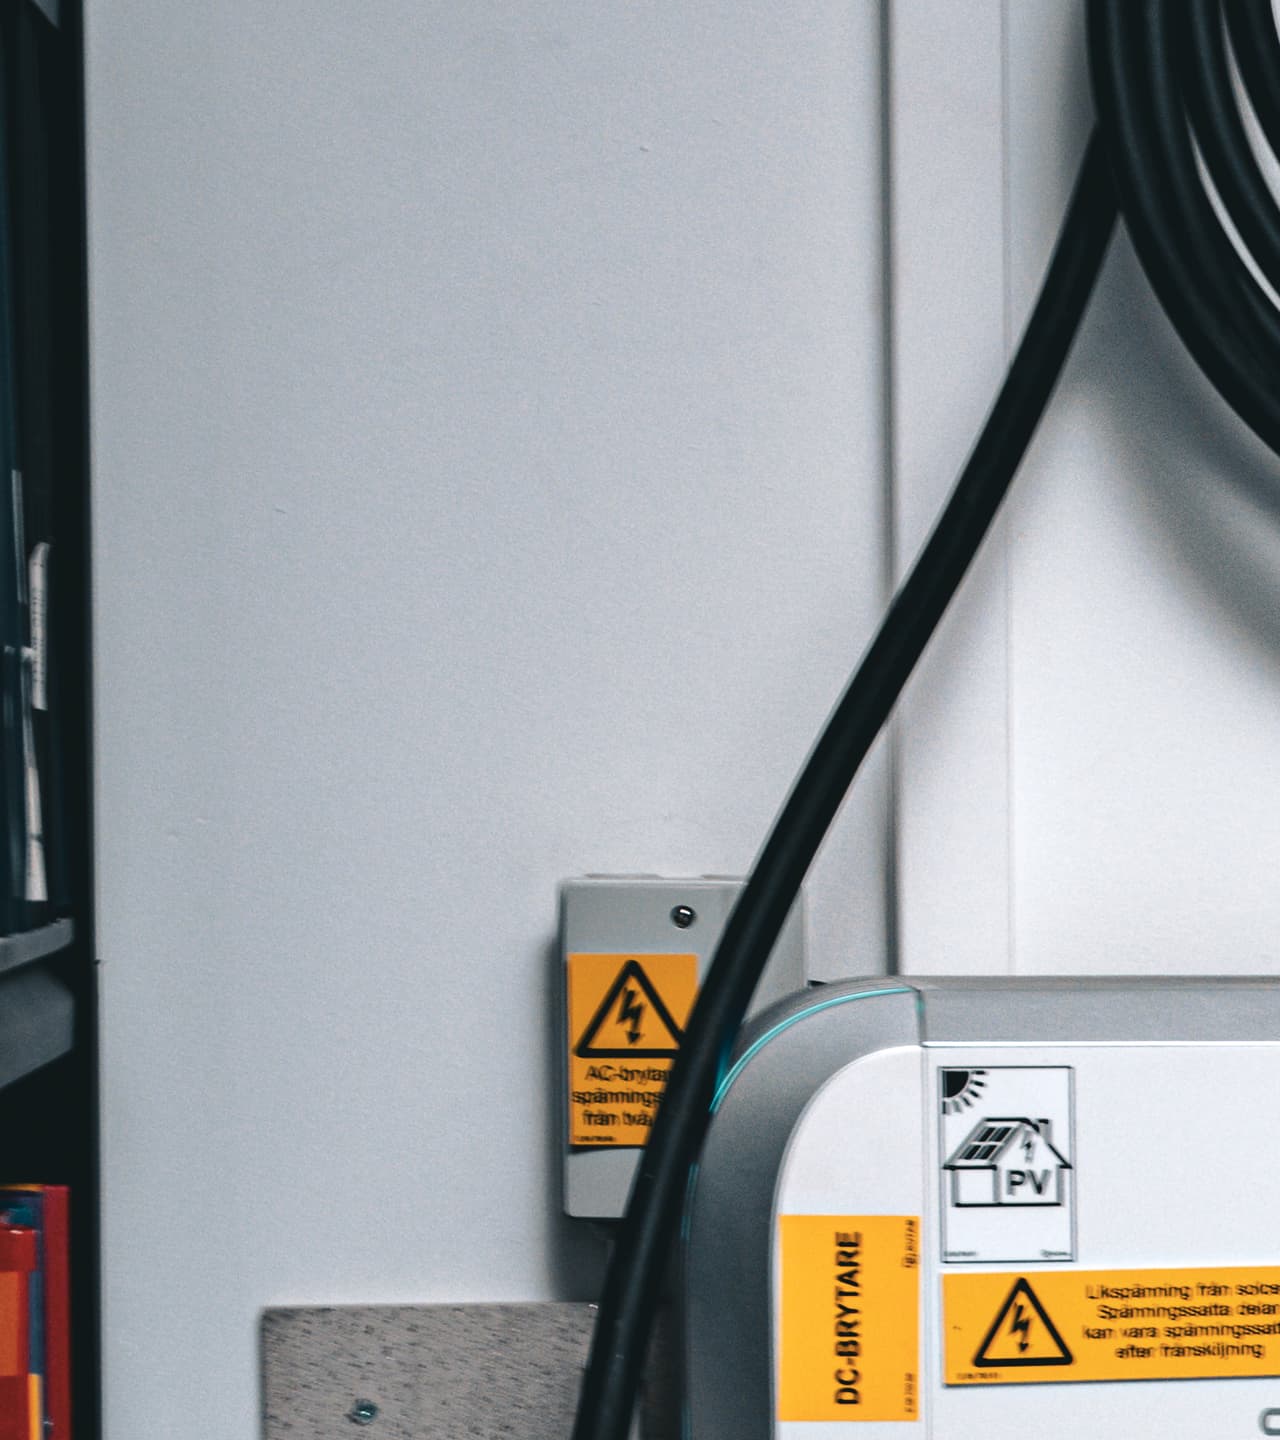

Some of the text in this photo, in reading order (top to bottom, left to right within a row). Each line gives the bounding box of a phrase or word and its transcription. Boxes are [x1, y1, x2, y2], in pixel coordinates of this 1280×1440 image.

[585, 1064, 669, 1086] AC-bryta
[572, 1087, 664, 1108] spännings
[1006, 1167, 1052, 1195] PV
[834, 1231, 862, 1406] DC-BRYTARE
